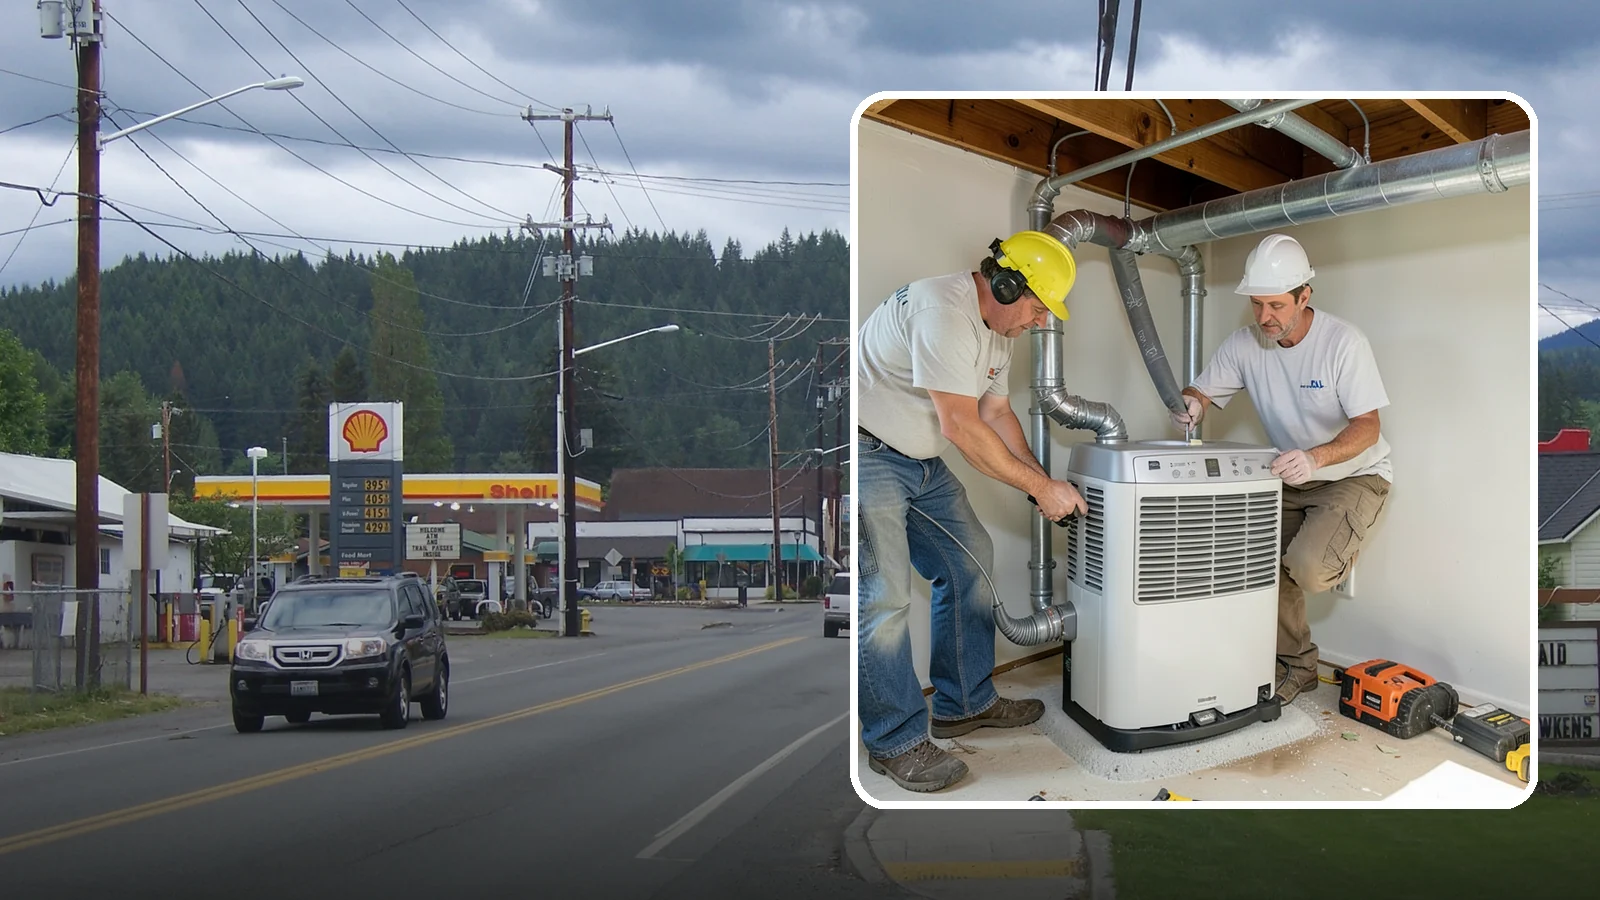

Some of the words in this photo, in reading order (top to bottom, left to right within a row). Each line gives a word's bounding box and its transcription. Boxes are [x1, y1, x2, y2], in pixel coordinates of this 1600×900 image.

[366, 480, 383, 490] 395
[490, 484, 547, 499] Shell
[366, 494, 383, 504] 405
[366, 508, 383, 518] 415
[366, 522, 383, 532] 429
[1538, 643, 1567, 665] AID
